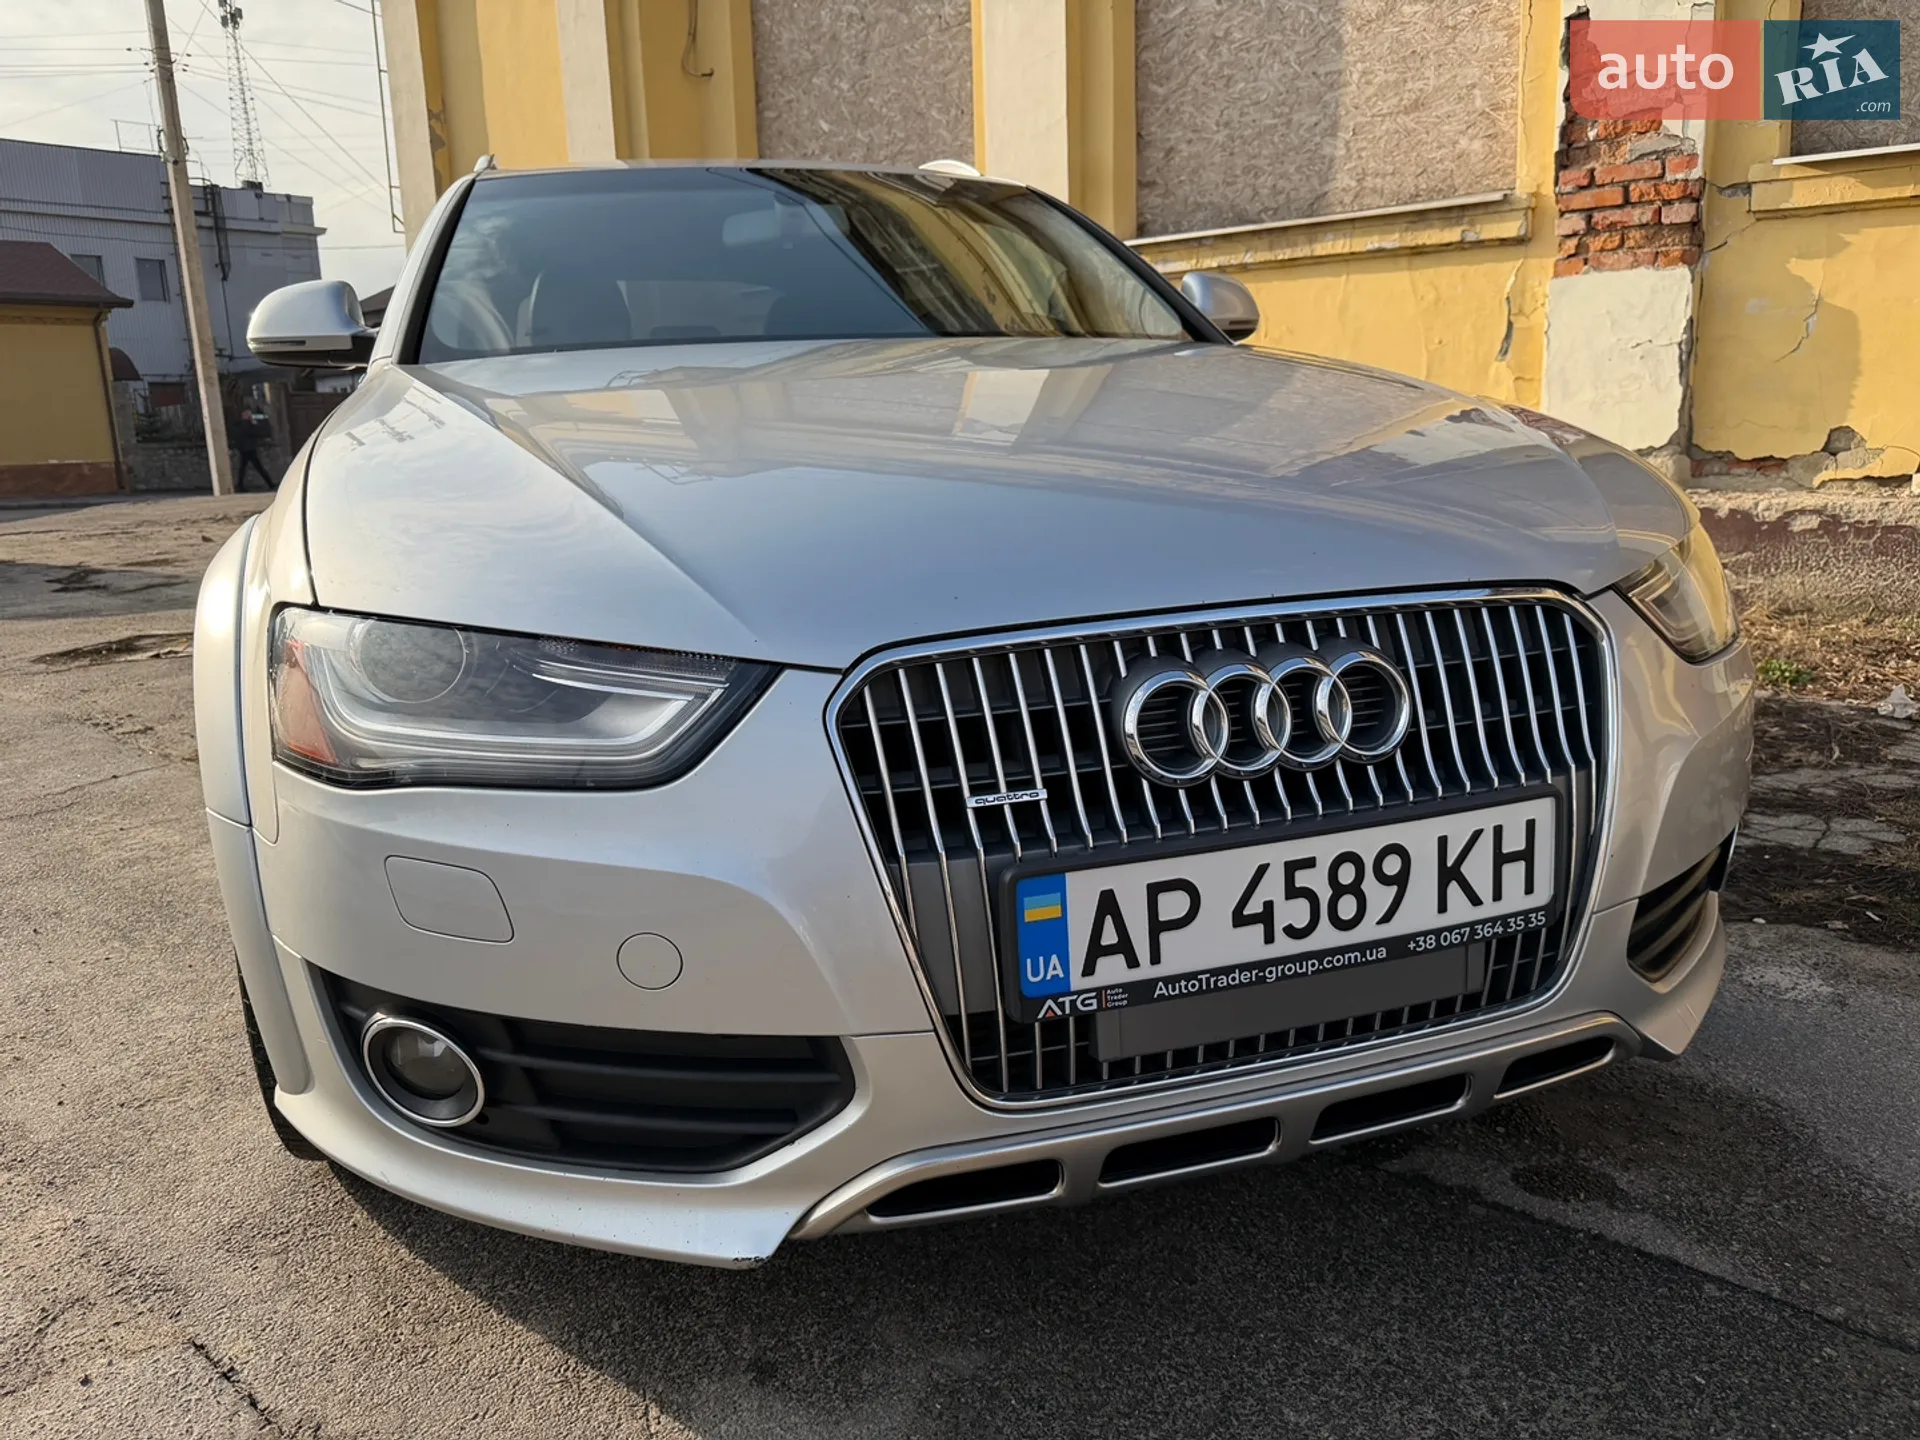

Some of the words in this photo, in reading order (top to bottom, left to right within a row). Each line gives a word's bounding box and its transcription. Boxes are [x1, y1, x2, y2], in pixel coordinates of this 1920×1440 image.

[974, 791, 1040, 805] quattro
[1081, 877, 1202, 978] AP
[1231, 842, 1412, 945] 4589
[1437, 818, 1536, 914] KH
[1407, 934, 1436, 951] +38
[1440, 927, 1470, 946] 067
[1474, 920, 1504, 939] 364
[1507, 915, 1525, 932] 35
[1528, 911, 1546, 927] 35
[1026, 954, 1065, 983] UA
[1153, 946, 1388, 998] AutoTrader-group.com.ua
[1037, 992, 1098, 1019] ATG
[1106, 1000, 1128, 1008] Group
[1107, 993, 1129, 1001] Trader
